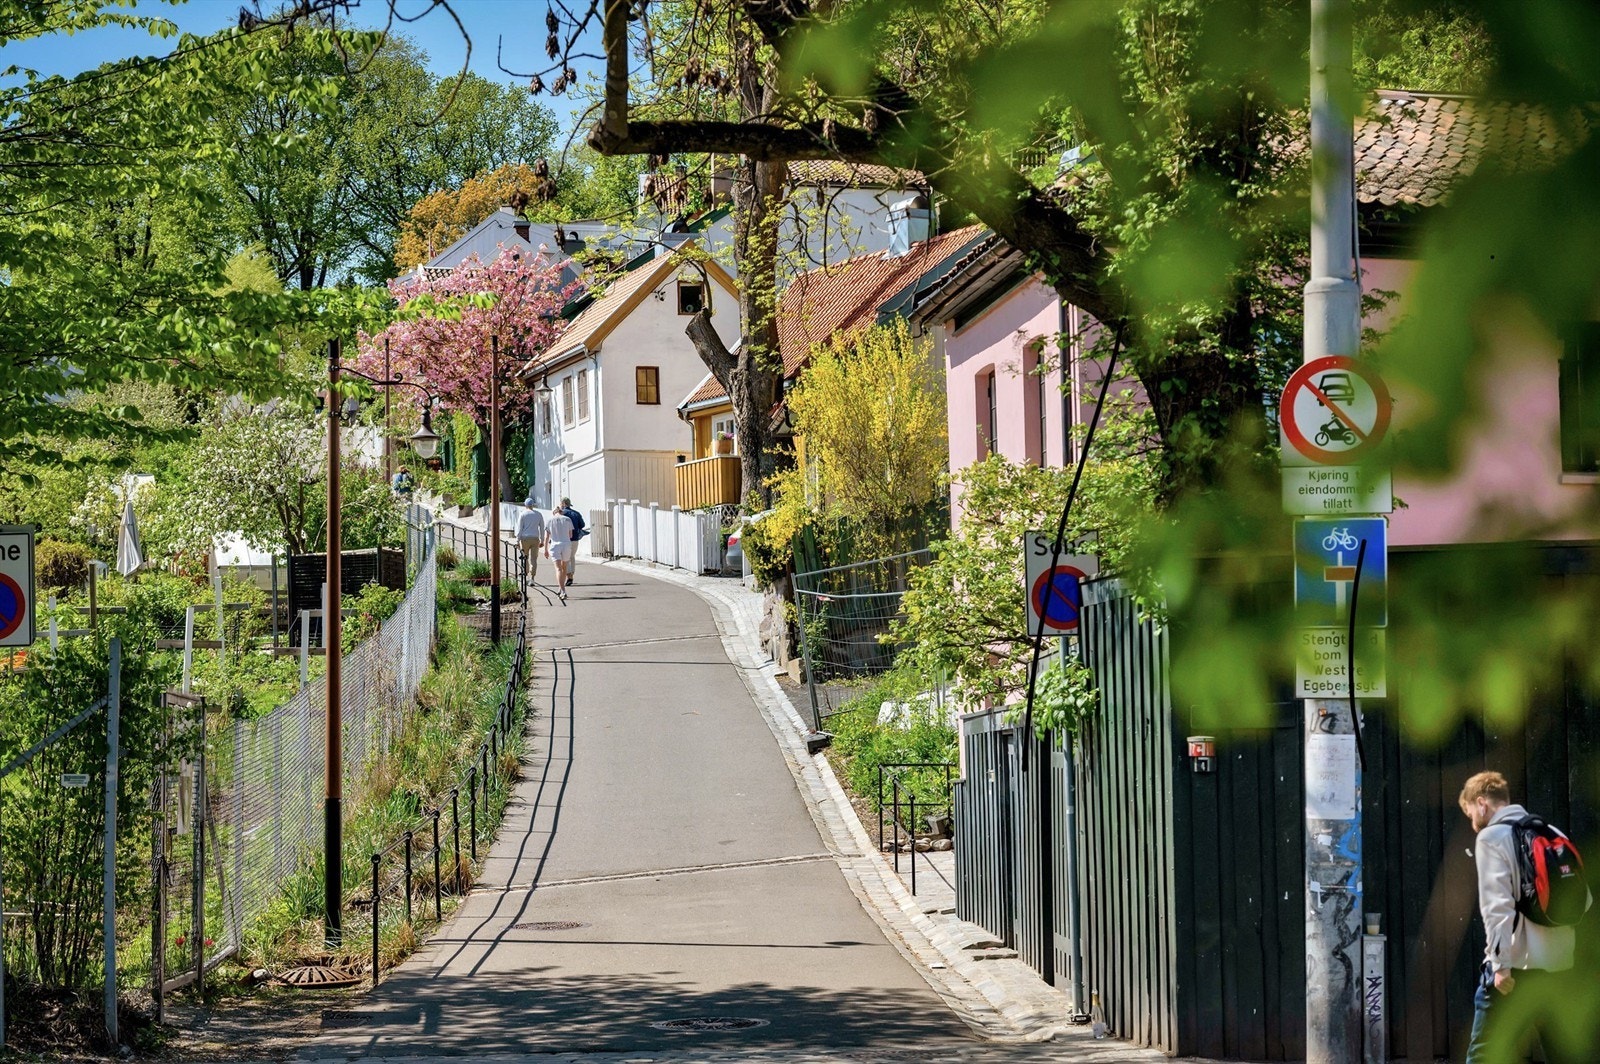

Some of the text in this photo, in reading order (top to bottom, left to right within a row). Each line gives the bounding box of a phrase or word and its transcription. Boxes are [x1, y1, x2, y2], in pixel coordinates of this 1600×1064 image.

[1309, 470, 1349, 483] Kjøring
[1298, 484, 1375, 495] eiendomme
[1323, 498, 1353, 509] tillatt
[1302, 633, 1346, 647] Stengt
[1314, 650, 1342, 661] bom
[1313, 665, 1364, 676] Weste
